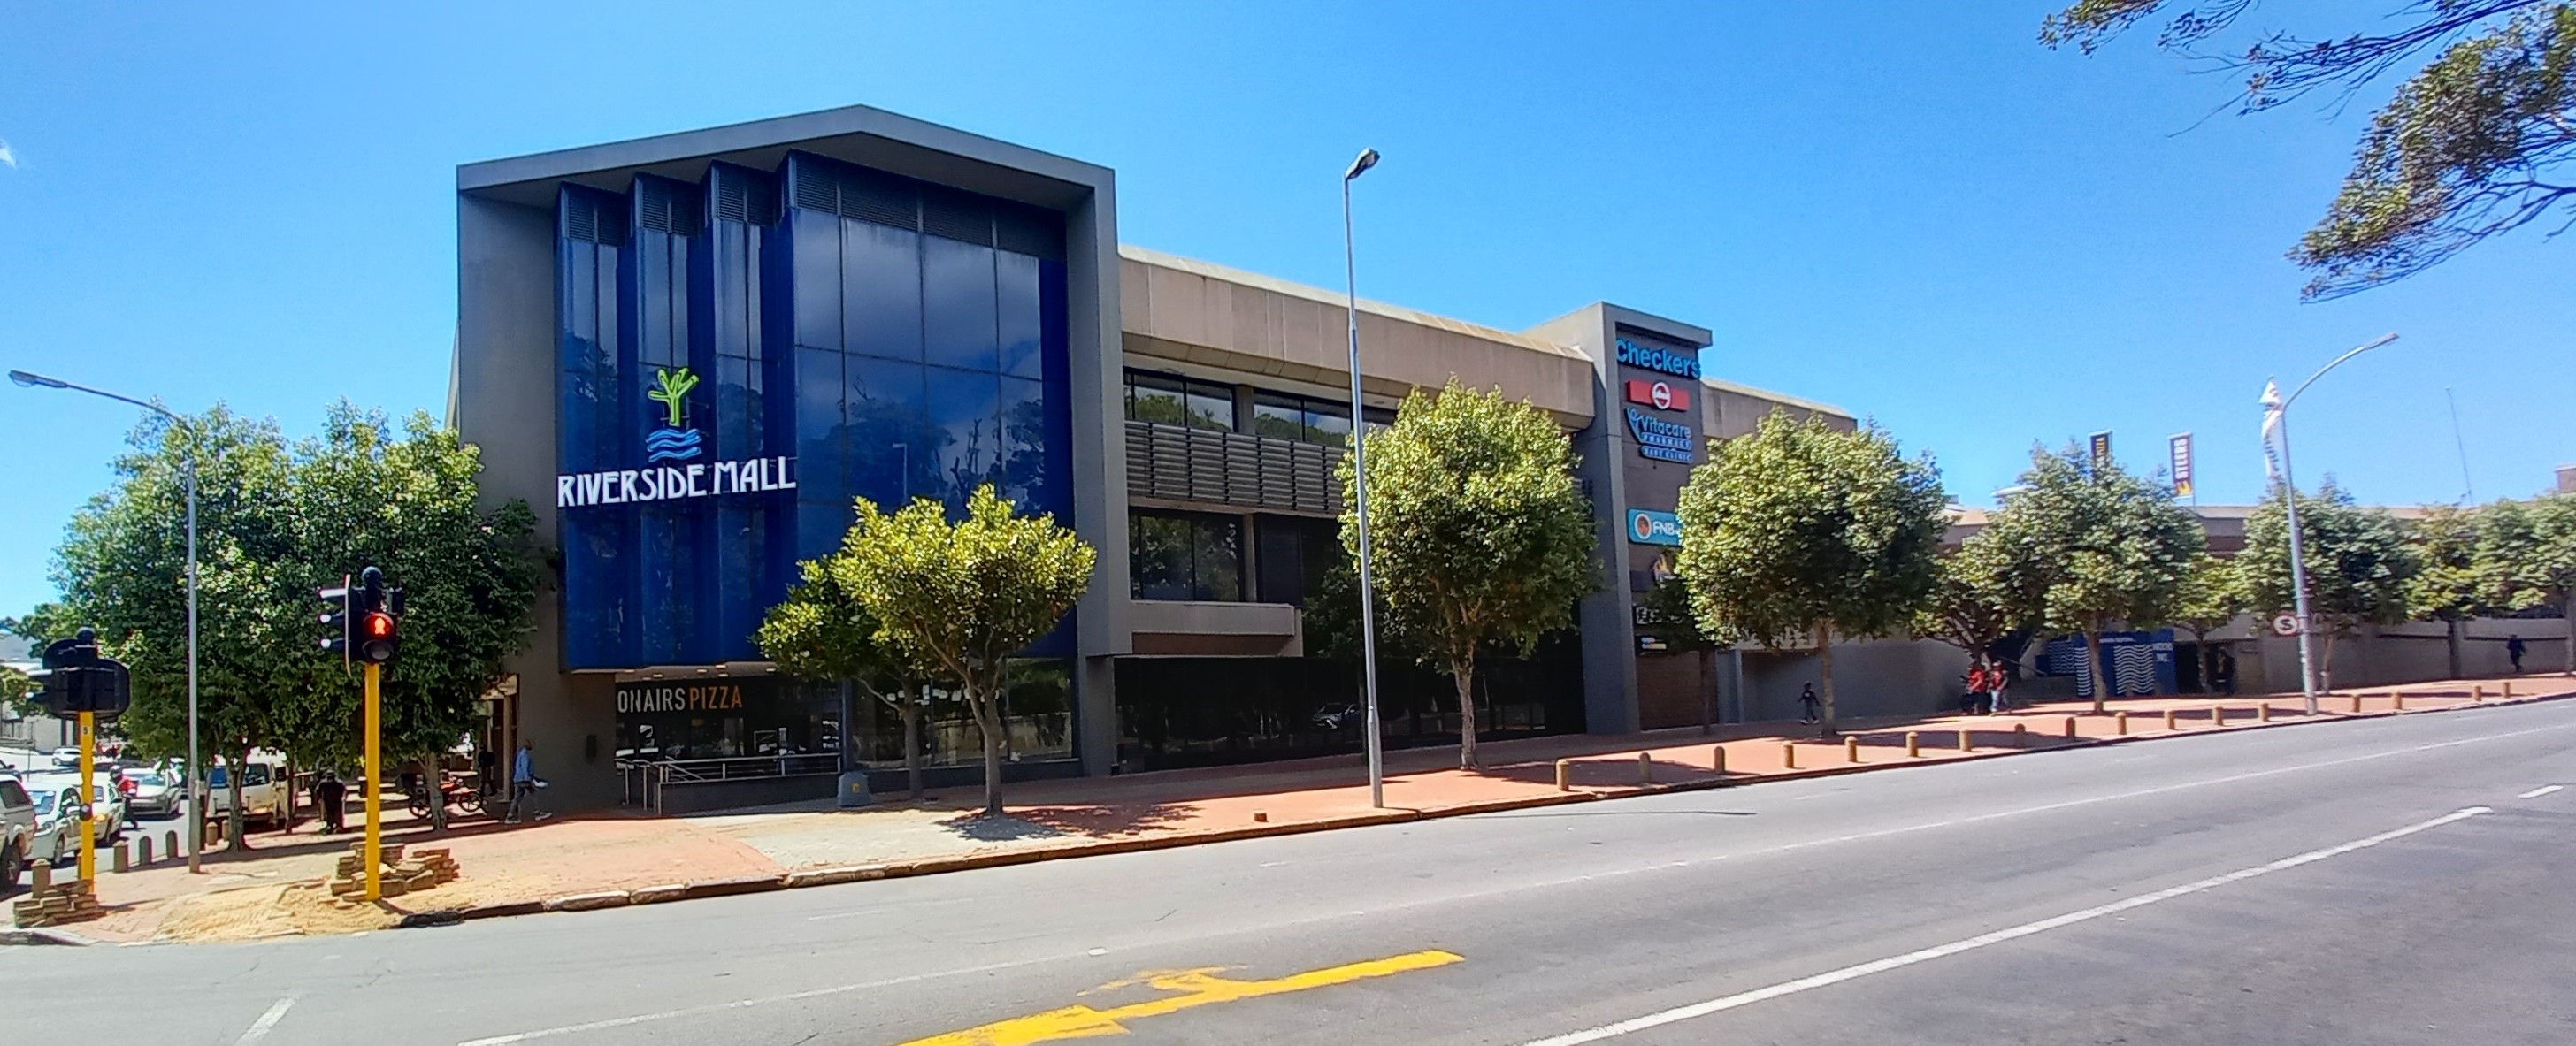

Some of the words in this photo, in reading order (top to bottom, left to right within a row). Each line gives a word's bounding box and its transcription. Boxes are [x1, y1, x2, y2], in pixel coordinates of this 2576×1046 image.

[1615, 340, 1701, 378] Checkers
[1640, 415, 1692, 439] Vitacare
[1643, 433, 1691, 450] PHARMACY
[1665, 451, 1692, 462] CLINIC
[2174, 438, 2189, 480] STEERS
[557, 464, 707, 508] RIVERSIDE
[713, 456, 797, 494] MALL
[1652, 520, 1675, 536] FNB
[689, 685, 742, 710] PIZZA
